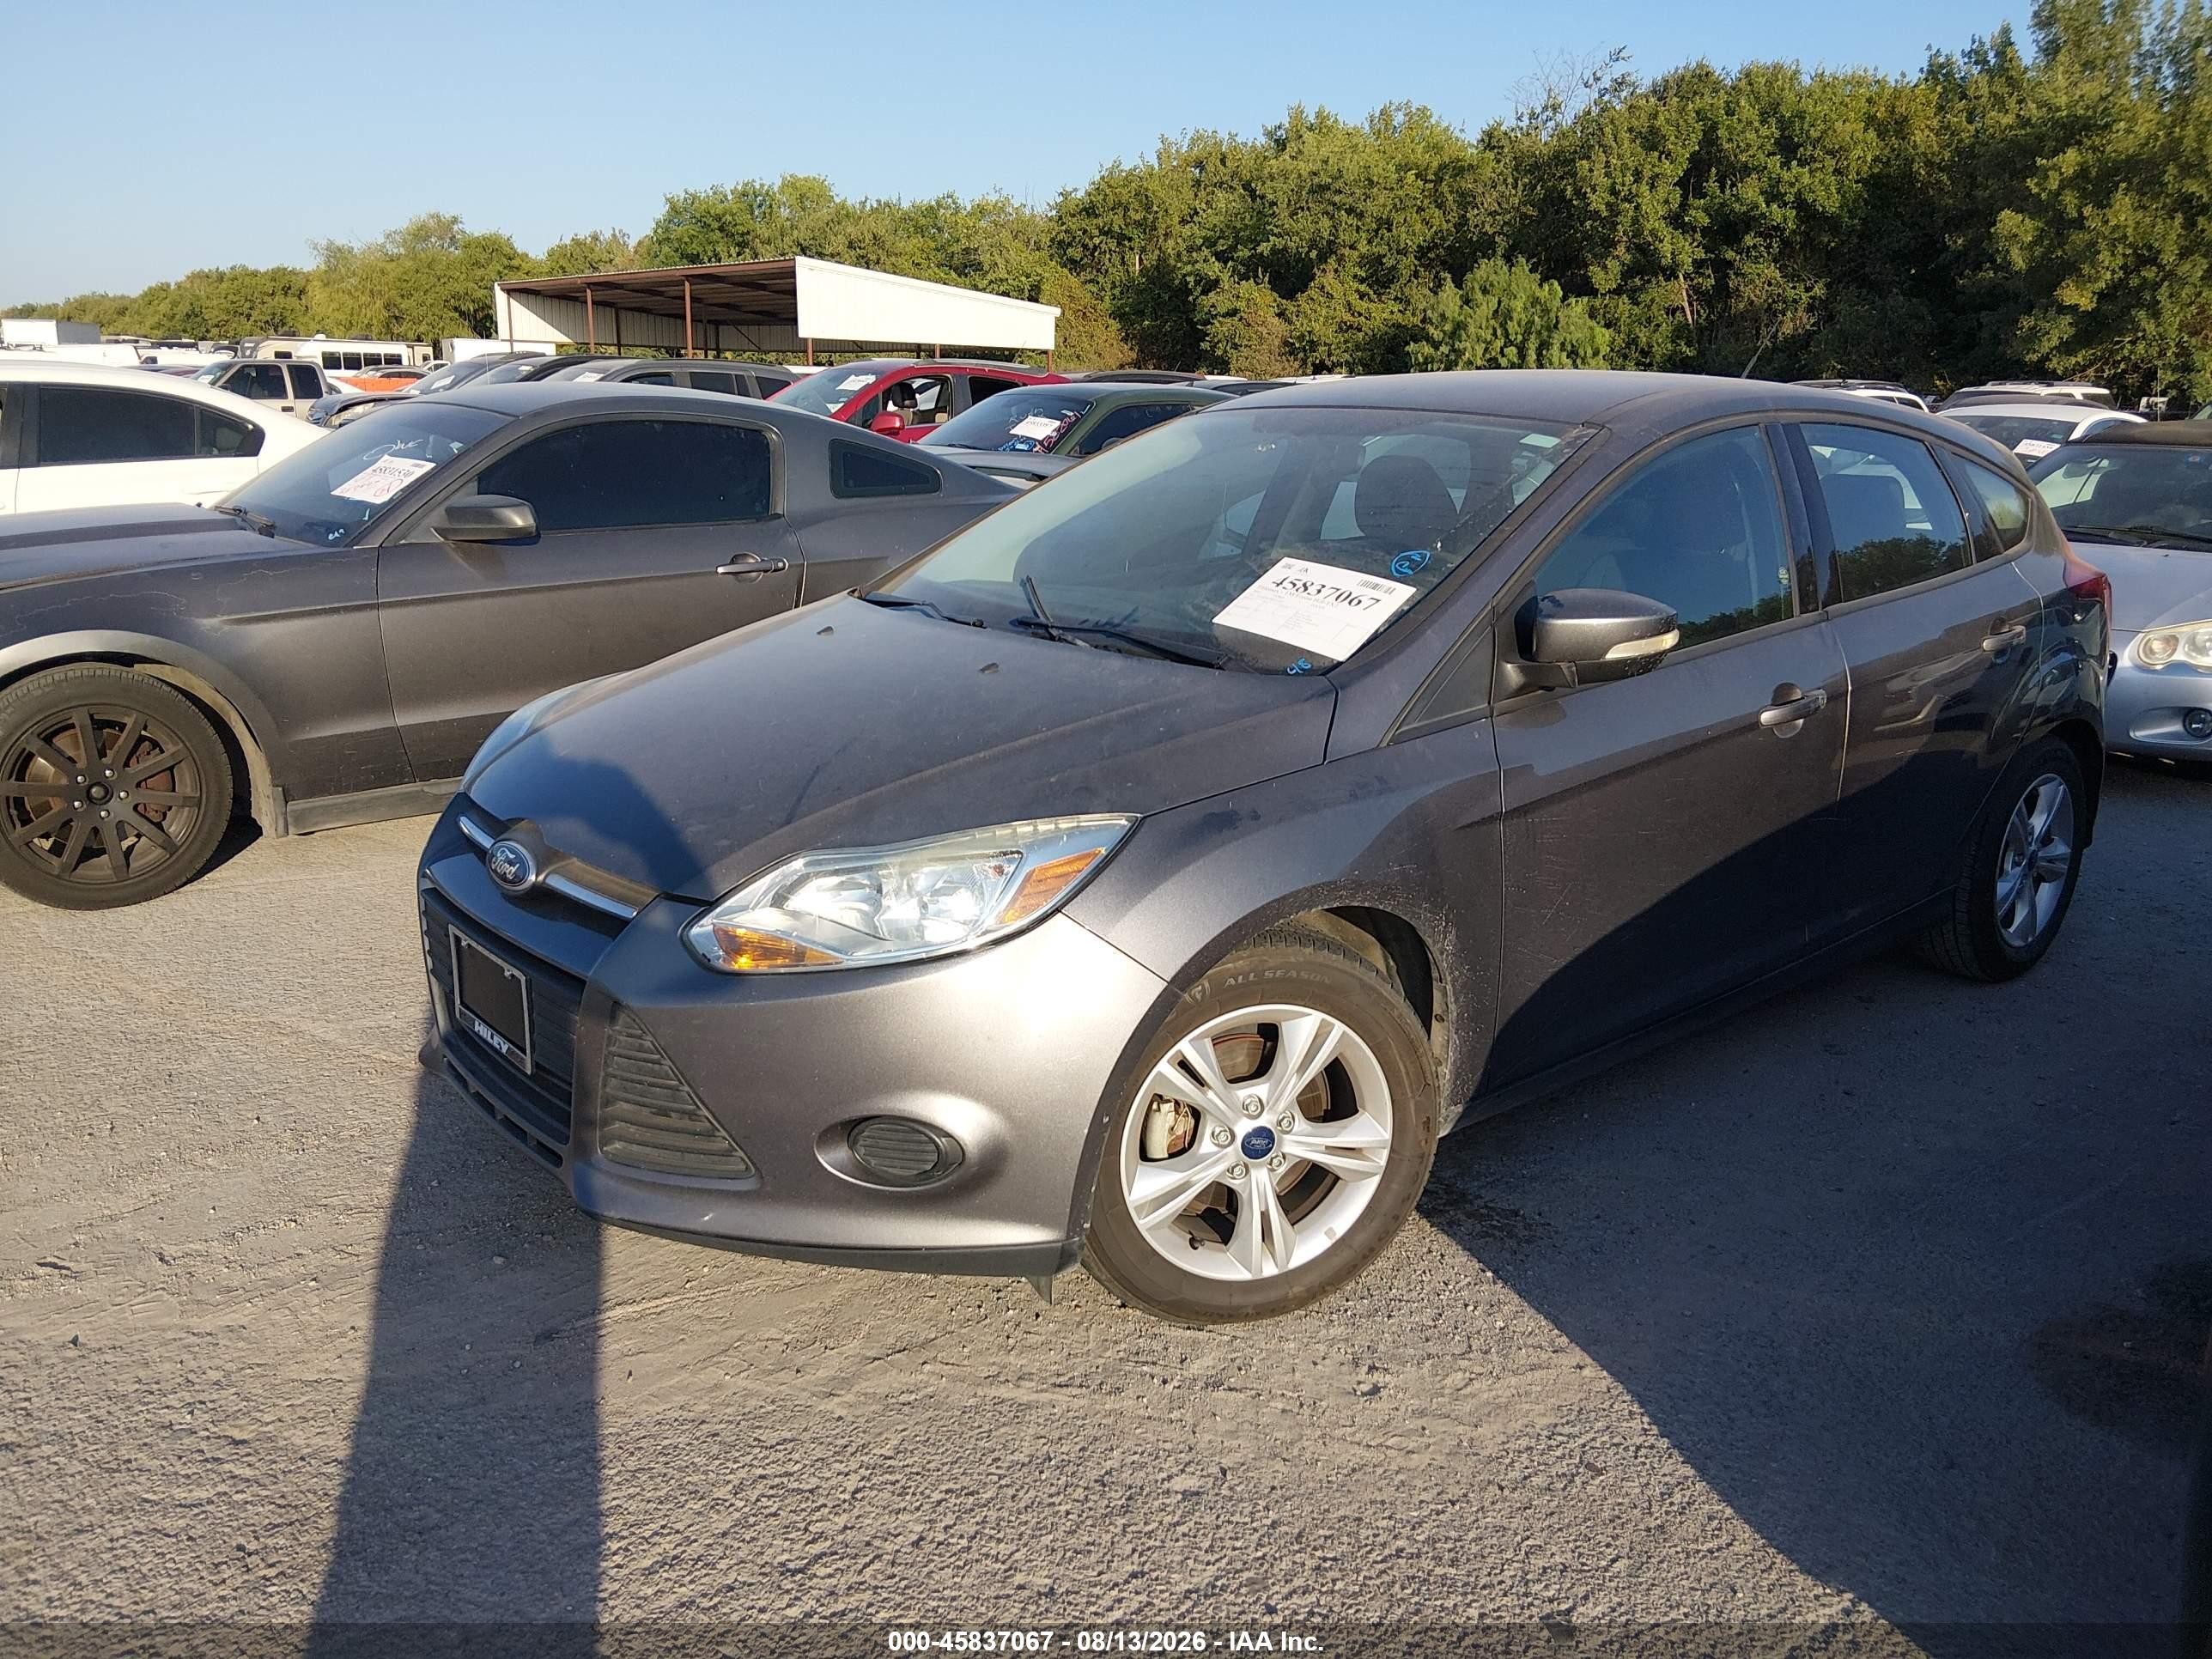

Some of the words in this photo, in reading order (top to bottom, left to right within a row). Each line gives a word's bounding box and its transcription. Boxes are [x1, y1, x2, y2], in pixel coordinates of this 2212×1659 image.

[1272, 575, 1382, 611] 45837067
[492, 847, 520, 880] Ford
[1224, 972, 1258, 988] ALL
[1263, 969, 1331, 985] SEASON
[475, 1019, 509, 1055] HILEY
